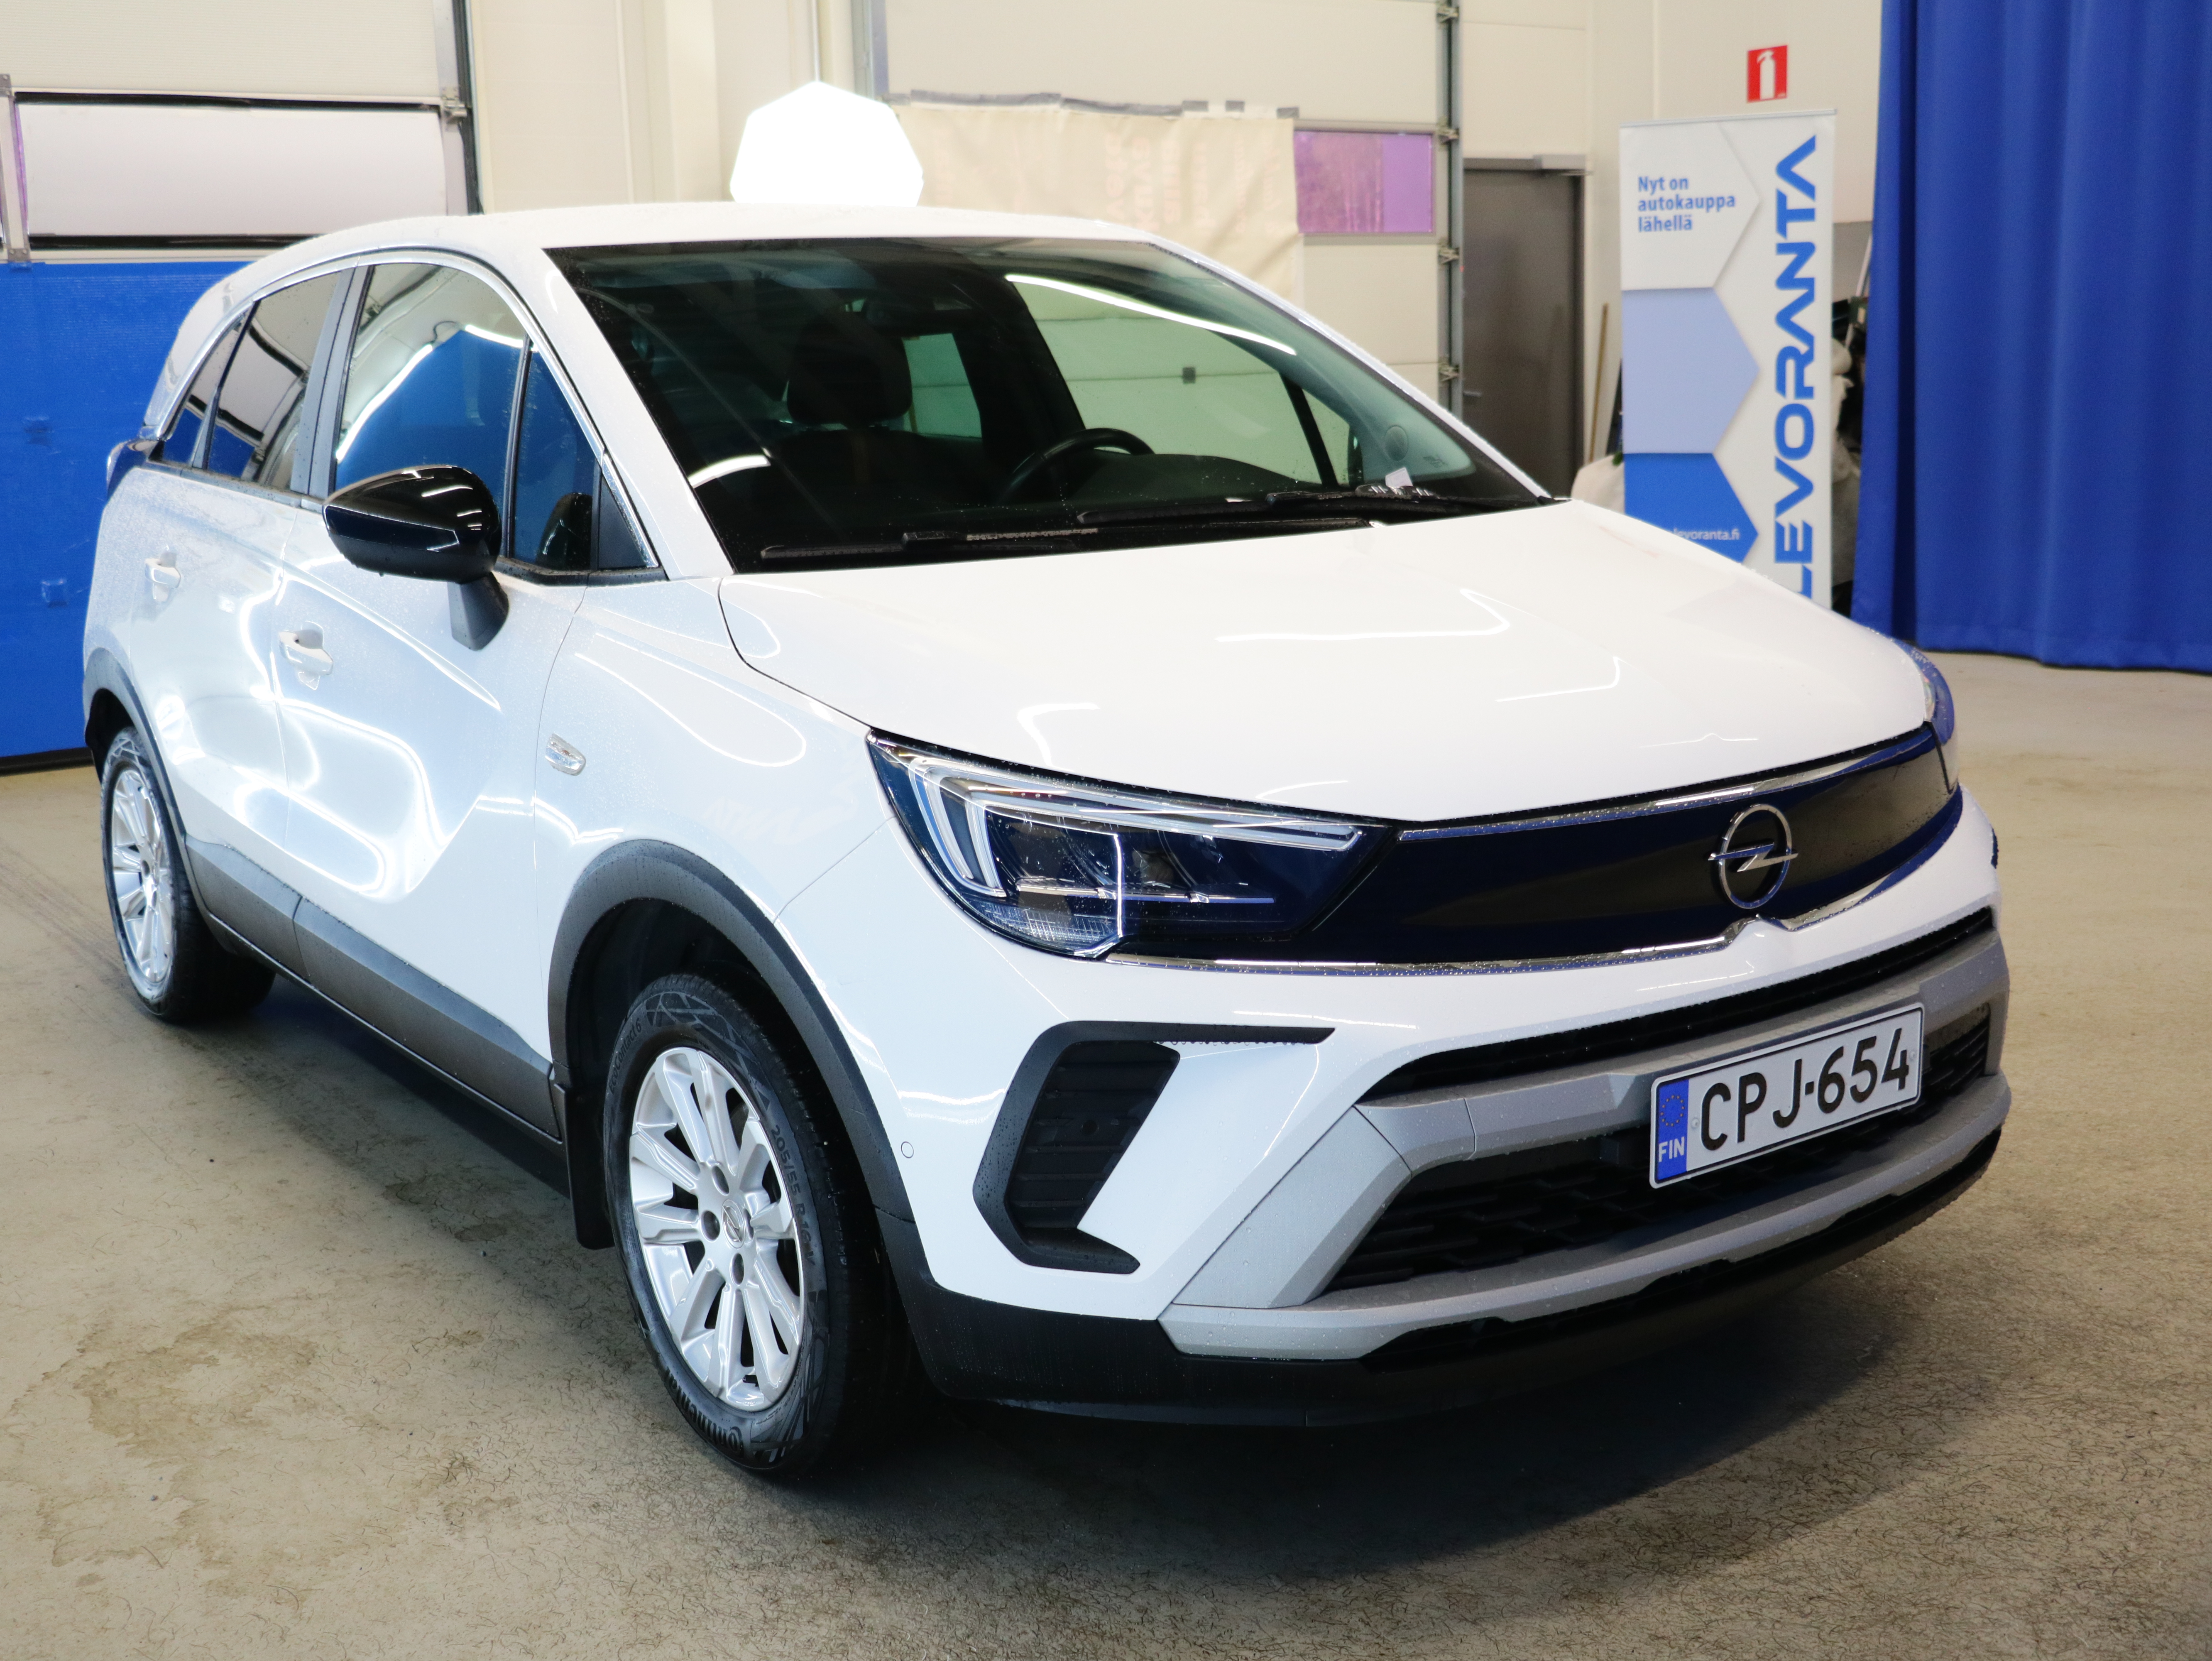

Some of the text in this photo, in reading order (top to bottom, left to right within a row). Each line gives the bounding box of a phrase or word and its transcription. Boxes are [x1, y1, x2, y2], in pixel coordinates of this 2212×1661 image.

[1638, 176, 1688, 196] Nyt on
[1639, 194, 1735, 213] autokauppa
[1639, 214, 1692, 232] lähellä
[1669, 528, 1740, 540] levoranta.fi
[609, 1018, 641, 1095] EcoContact 6
[1701, 1027, 1909, 1151] CPJ-654
[771, 1124, 800, 1196] 205/55
[1658, 1136, 1684, 1162] FIN
